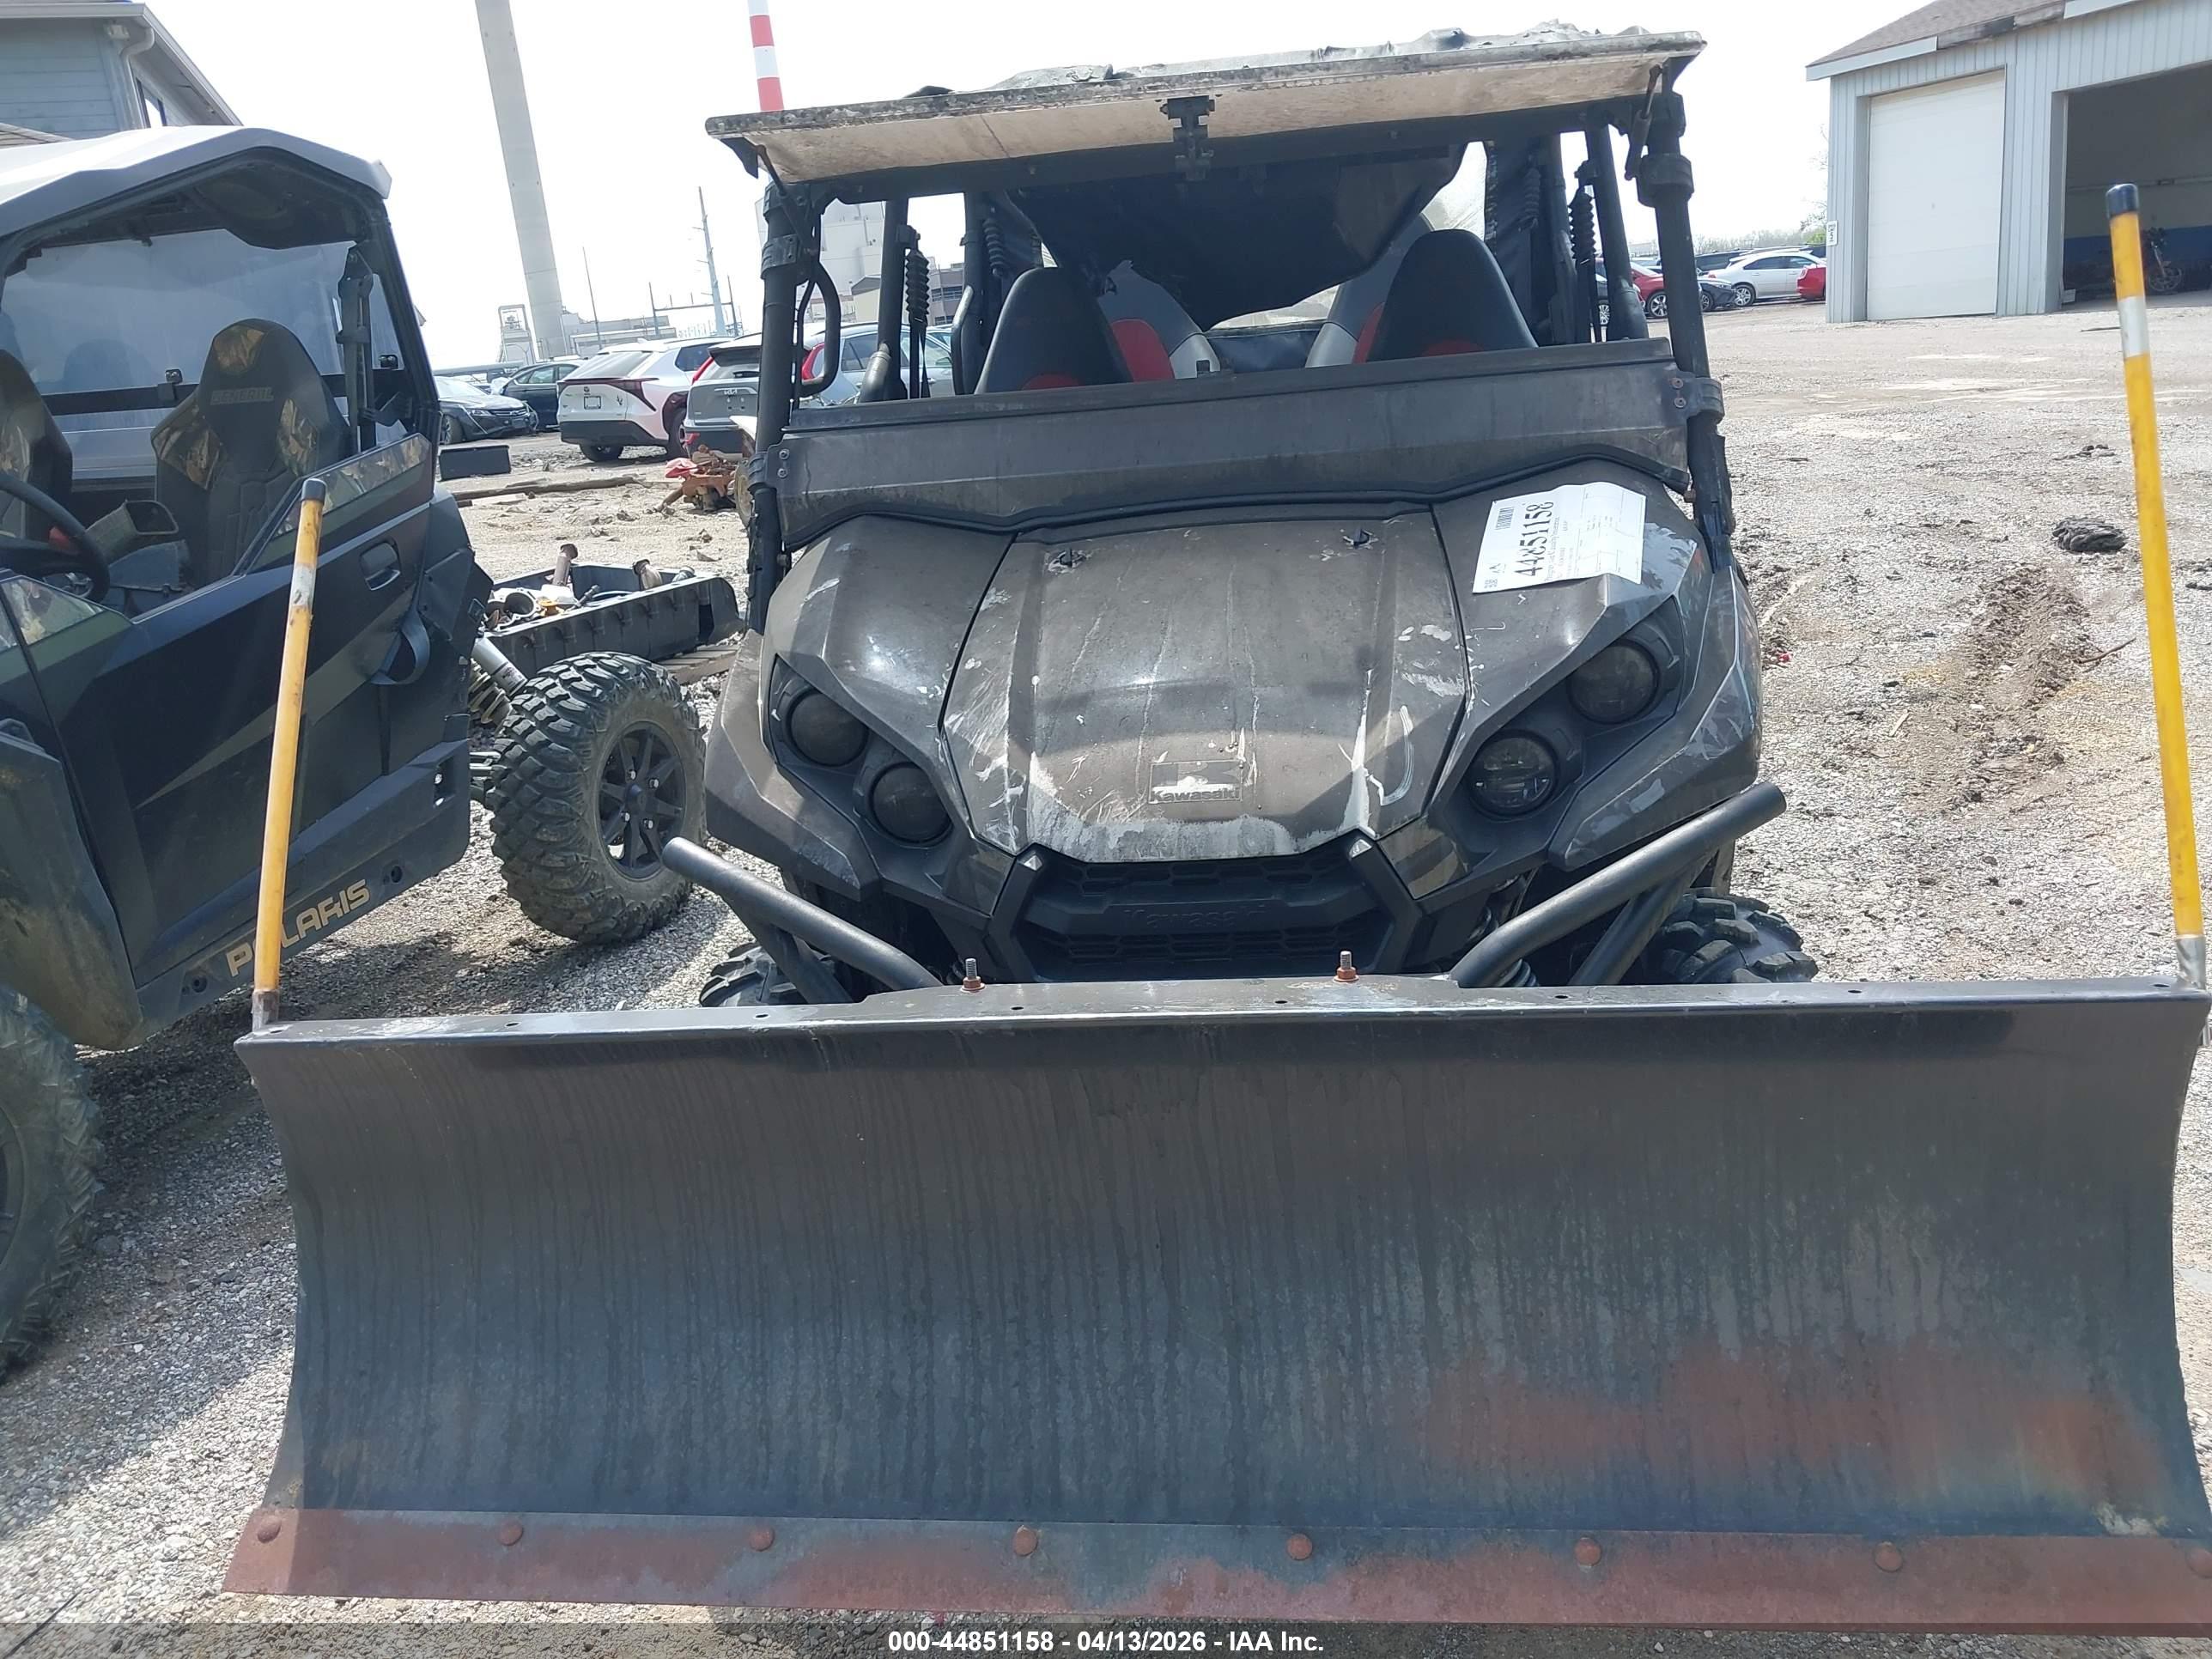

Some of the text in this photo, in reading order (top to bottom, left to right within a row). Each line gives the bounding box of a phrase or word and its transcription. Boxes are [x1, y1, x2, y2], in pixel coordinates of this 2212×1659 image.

[1513, 501, 1554, 577] 44851158
[1150, 787, 1240, 802] Kawasaki
[226, 878, 371, 977] PLARIS
